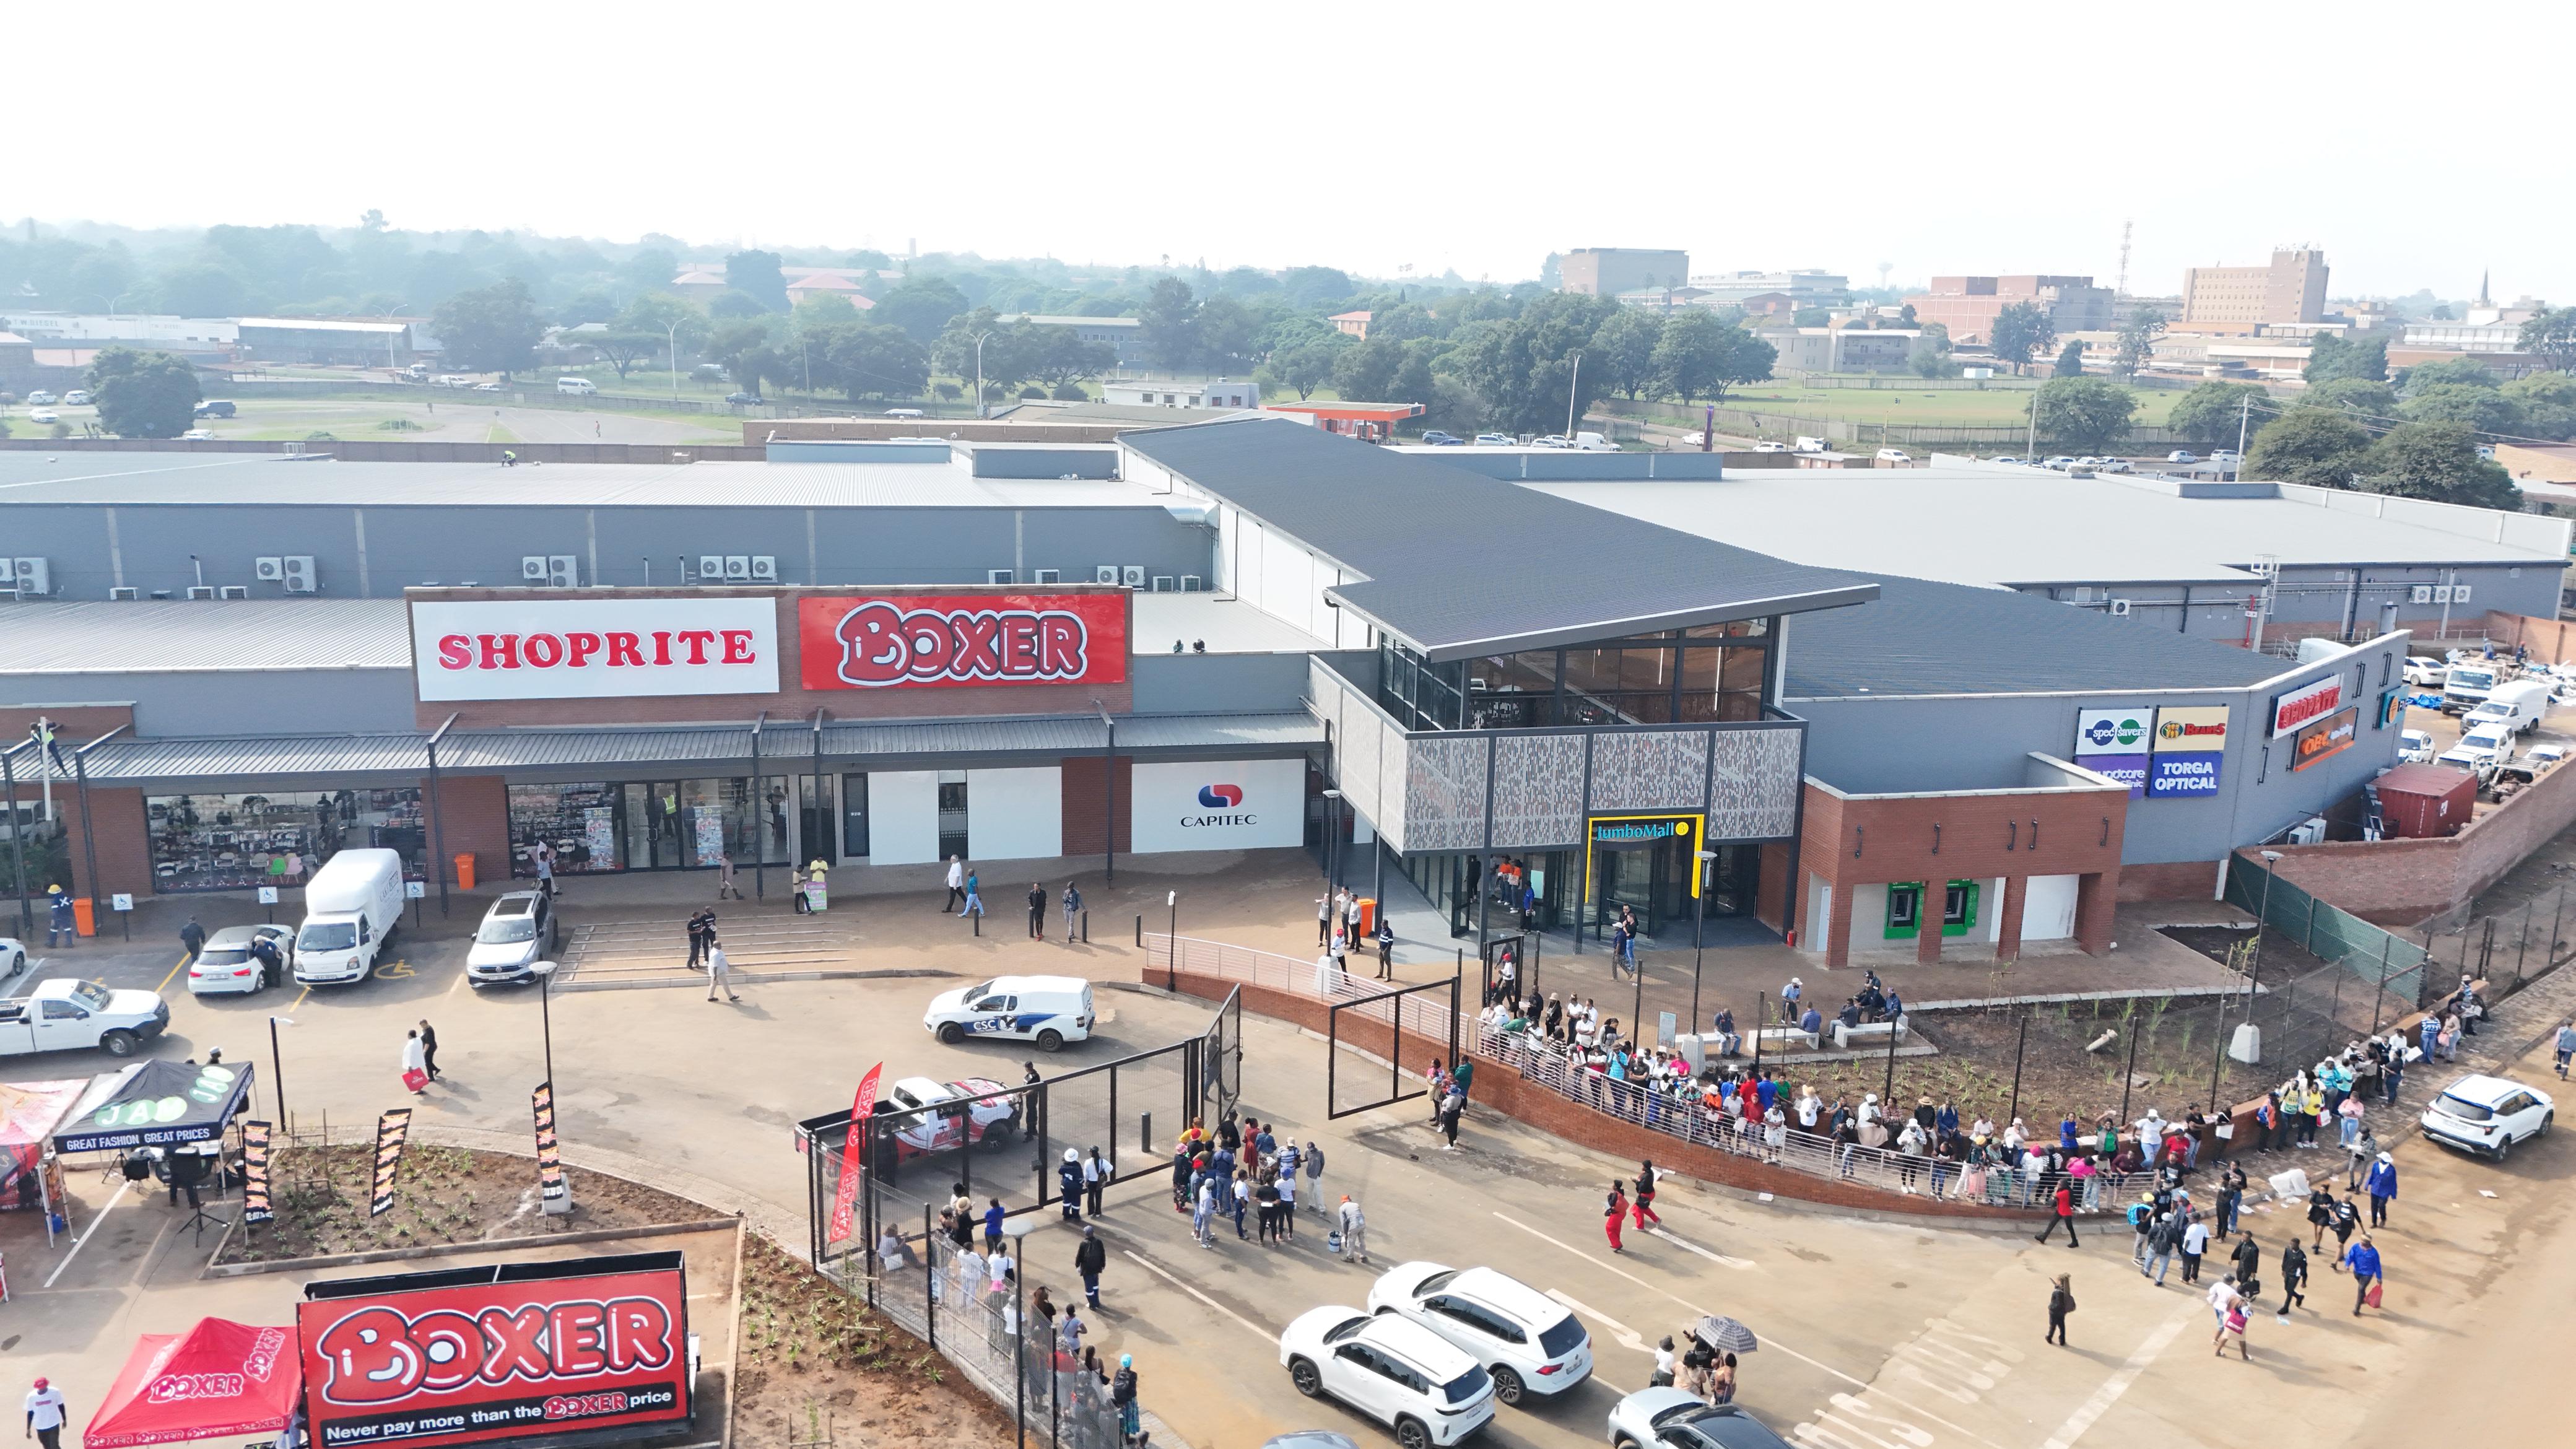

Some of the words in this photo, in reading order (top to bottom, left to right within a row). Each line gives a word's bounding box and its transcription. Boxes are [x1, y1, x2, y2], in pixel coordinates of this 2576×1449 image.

[437, 629, 757, 672] SHOPRITE
[835, 600, 1089, 687] BOXER
[2162, 762, 2214, 775] TORGA
[2154, 777, 2217, 791] OPTICAL
[1180, 814, 1257, 827] CAPITEC
[1596, 822, 1674, 842] JumboMall
[973, 1019, 996, 1030] CSC
[66, 1139, 97, 1151] GREAT
[98, 1134, 139, 1148] FASHION
[144, 1132, 174, 1144] GREAT
[176, 1128, 210, 1140] PRICES
[244, 1328, 285, 1382] BOXER
[316, 1295, 675, 1406] BOXER
[149, 1374, 244, 1403] BOXER
[326, 1426, 380, 1440] Never
[383, 1422, 416, 1435] pay
[419, 1414, 464, 1429] more
[471, 1411, 510, 1424] than
[514, 1406, 542, 1419] the
[543, 1391, 628, 1419] BOXER
[630, 1391, 672, 1409] price
